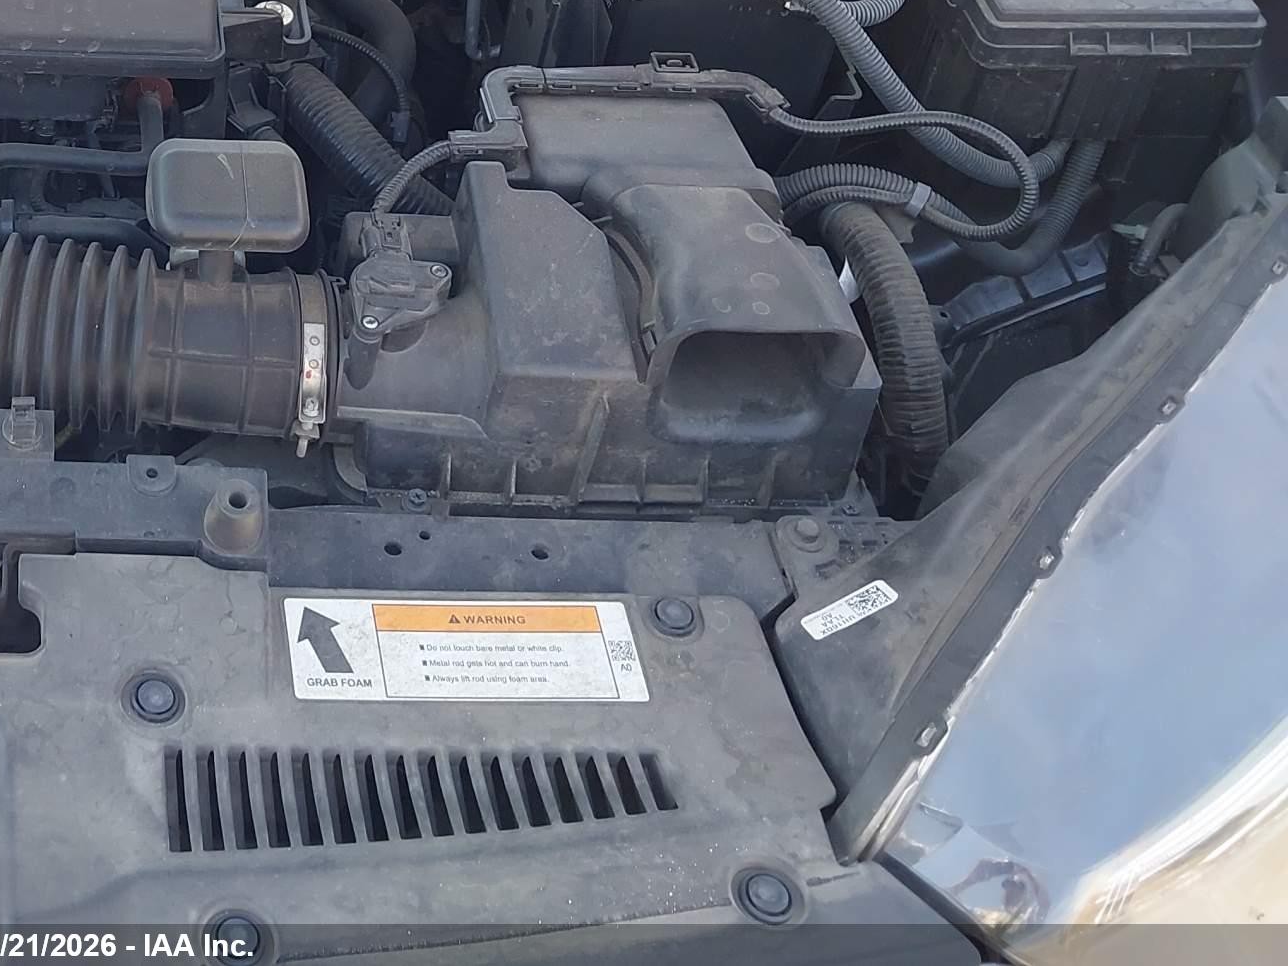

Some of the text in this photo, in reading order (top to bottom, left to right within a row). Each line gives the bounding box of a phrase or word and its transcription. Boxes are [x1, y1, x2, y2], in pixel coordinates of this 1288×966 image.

[464, 615, 526, 624] WARNING
[306, 677, 372, 688] GRAB FOAM
